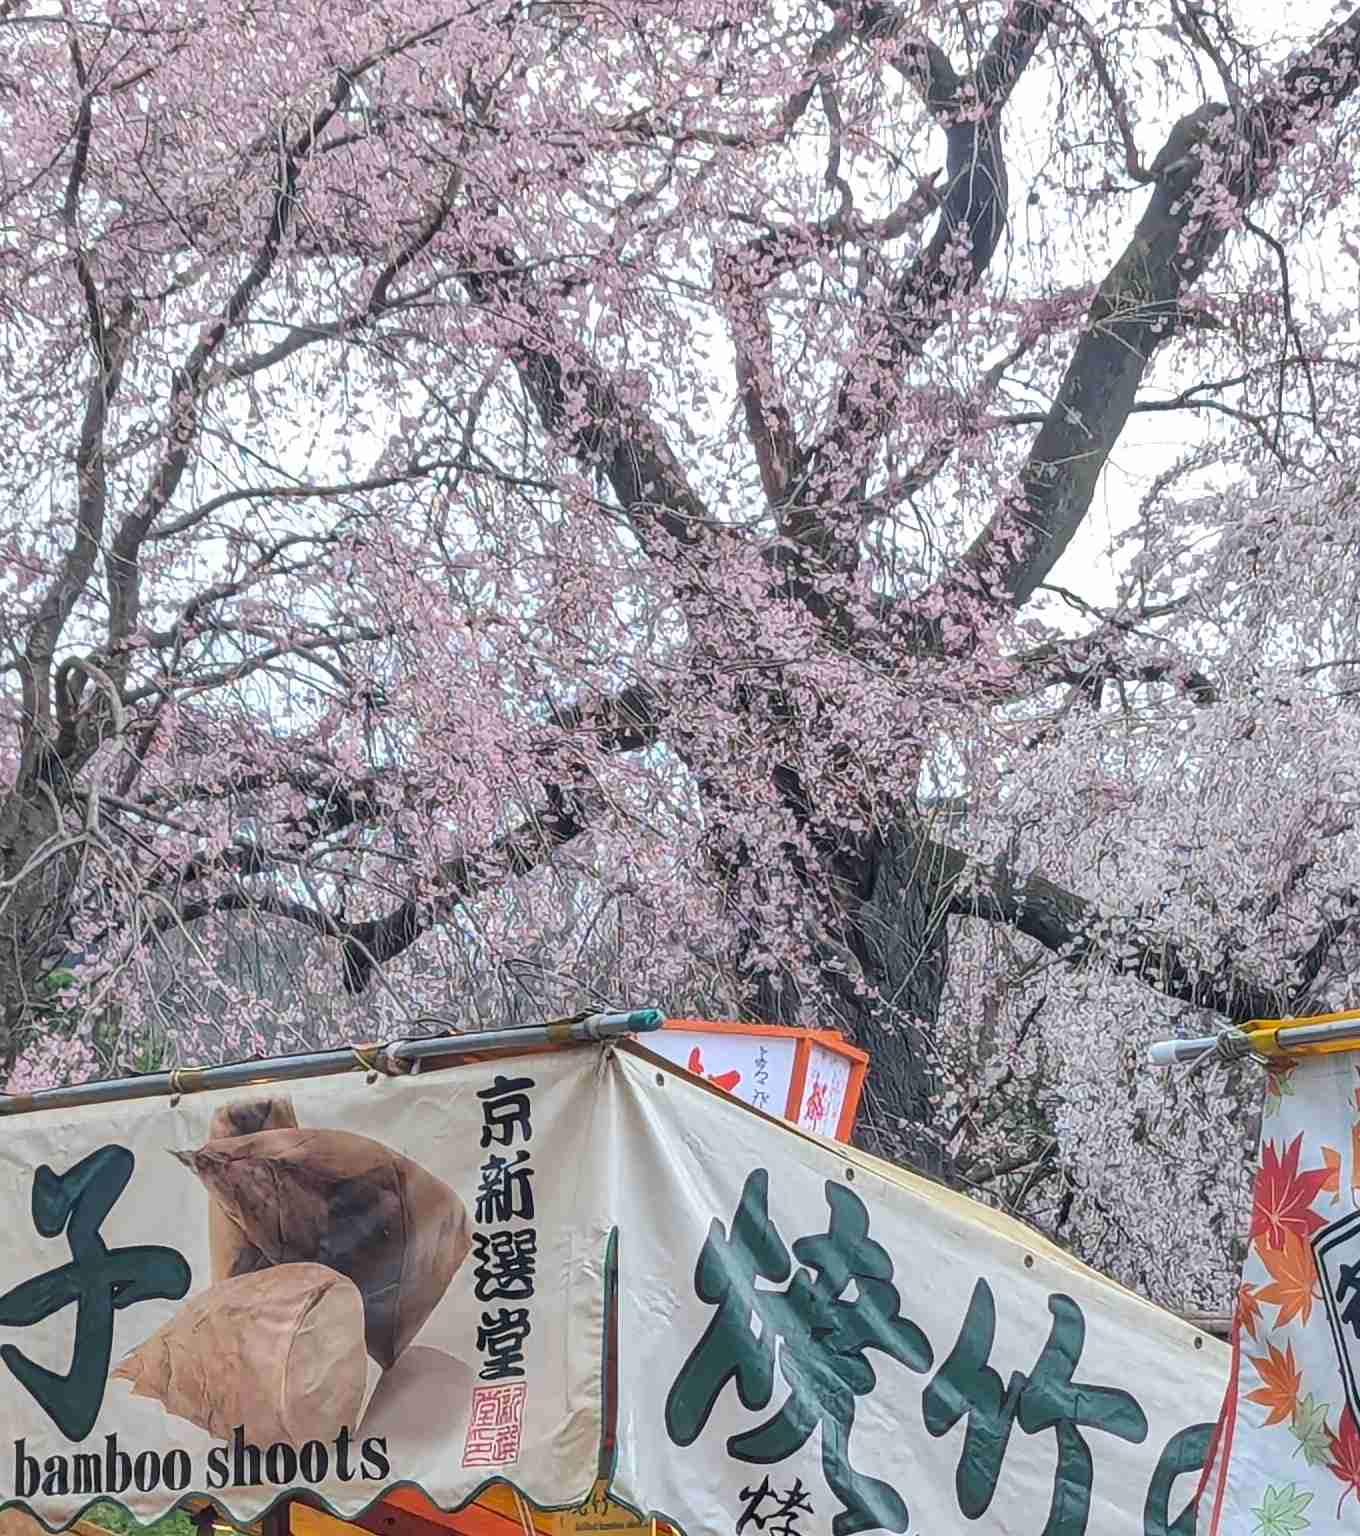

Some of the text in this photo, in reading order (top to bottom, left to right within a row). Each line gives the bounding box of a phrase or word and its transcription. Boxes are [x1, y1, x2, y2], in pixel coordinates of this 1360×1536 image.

[473, 1075, 537, 1380] 京新選堂
[14, 1431, 192, 1498] bamboo
[205, 1424, 391, 1488] shoots
